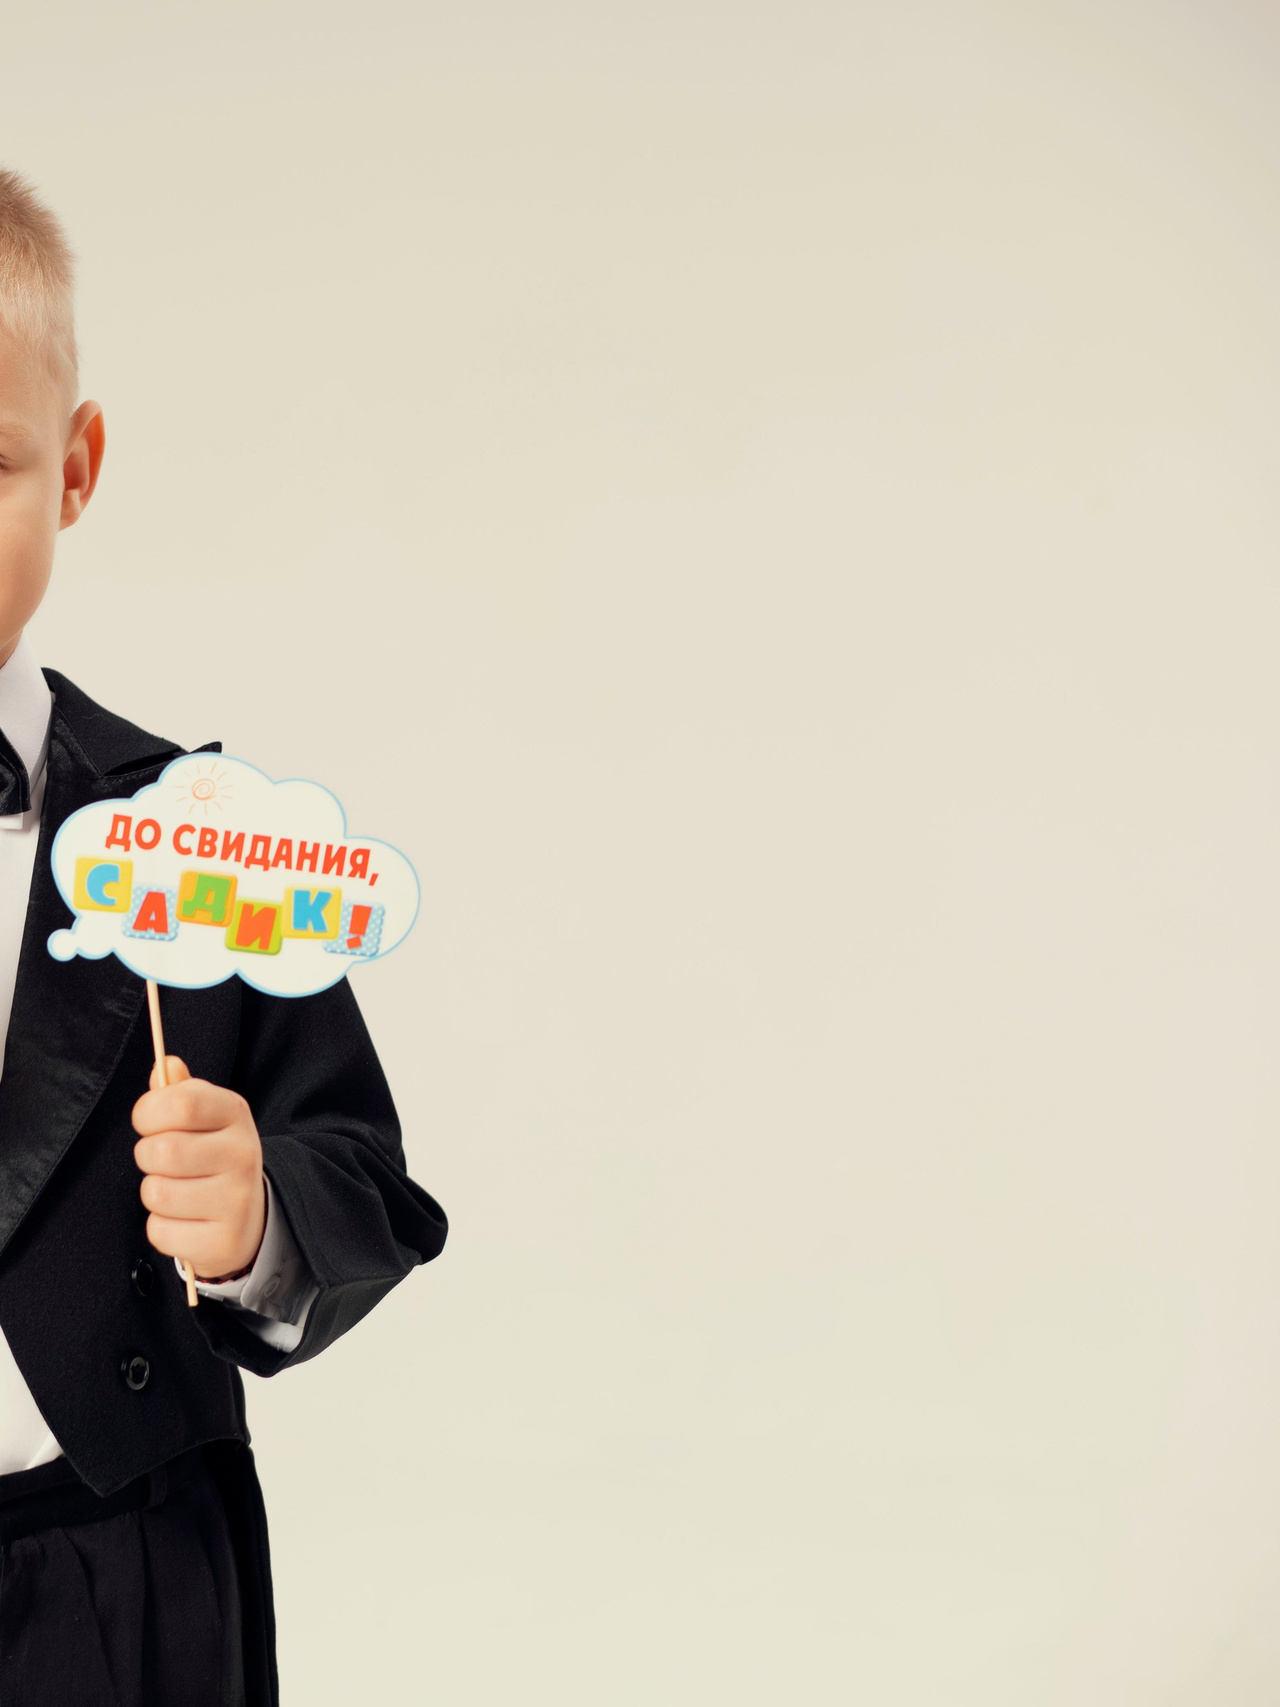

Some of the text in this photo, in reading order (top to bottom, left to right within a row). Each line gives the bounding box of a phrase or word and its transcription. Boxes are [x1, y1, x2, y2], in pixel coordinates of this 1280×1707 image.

[104, 814, 379, 887] ДО СВИДАНИЯ,
[86, 863, 372, 951] САДИК!
